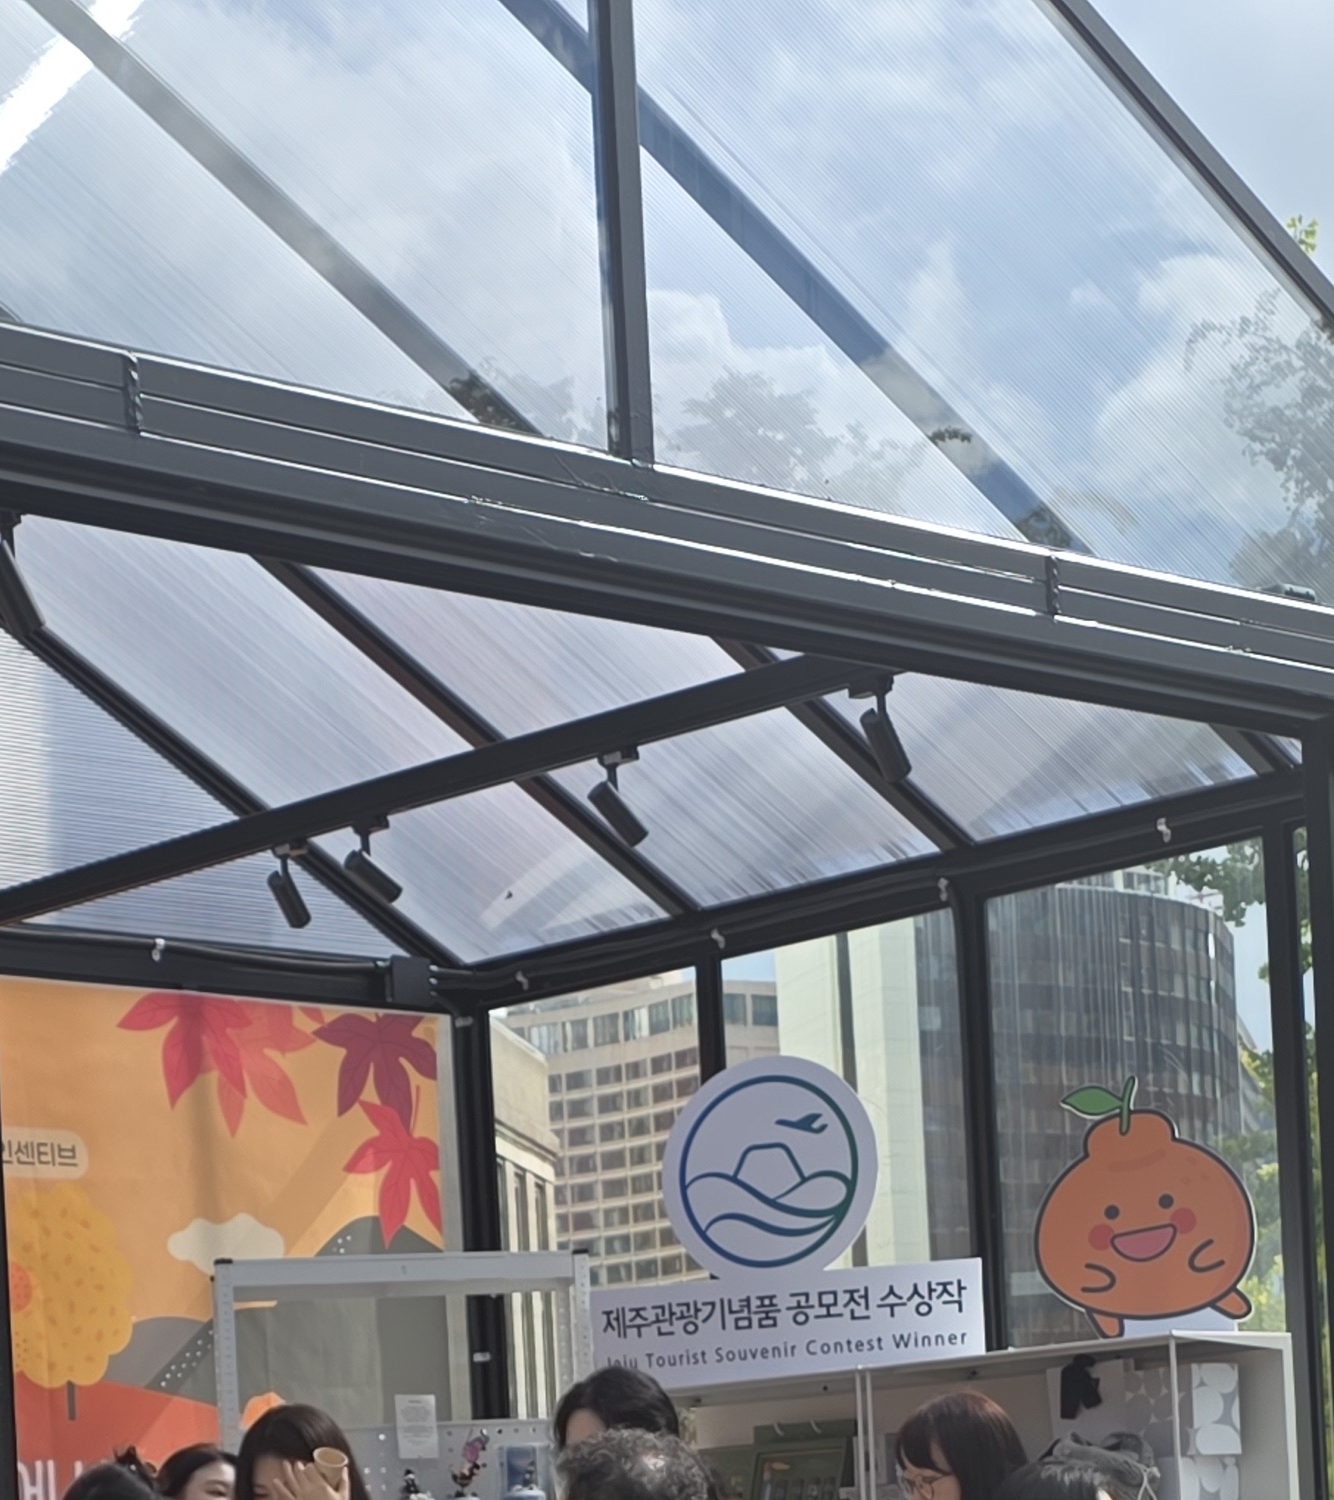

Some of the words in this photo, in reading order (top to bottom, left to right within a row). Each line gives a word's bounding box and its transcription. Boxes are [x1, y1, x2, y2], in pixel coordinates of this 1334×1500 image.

[602, 1292, 782, 1340] 제주관광기념품
[786, 1284, 871, 1327] 공모전
[877, 1278, 968, 1319] 수상작
[646, 1351, 708, 1369] Tourist
[715, 1342, 797, 1363] Souvenir
[805, 1335, 883, 1356] Contest
[892, 1330, 968, 1349] Winner
